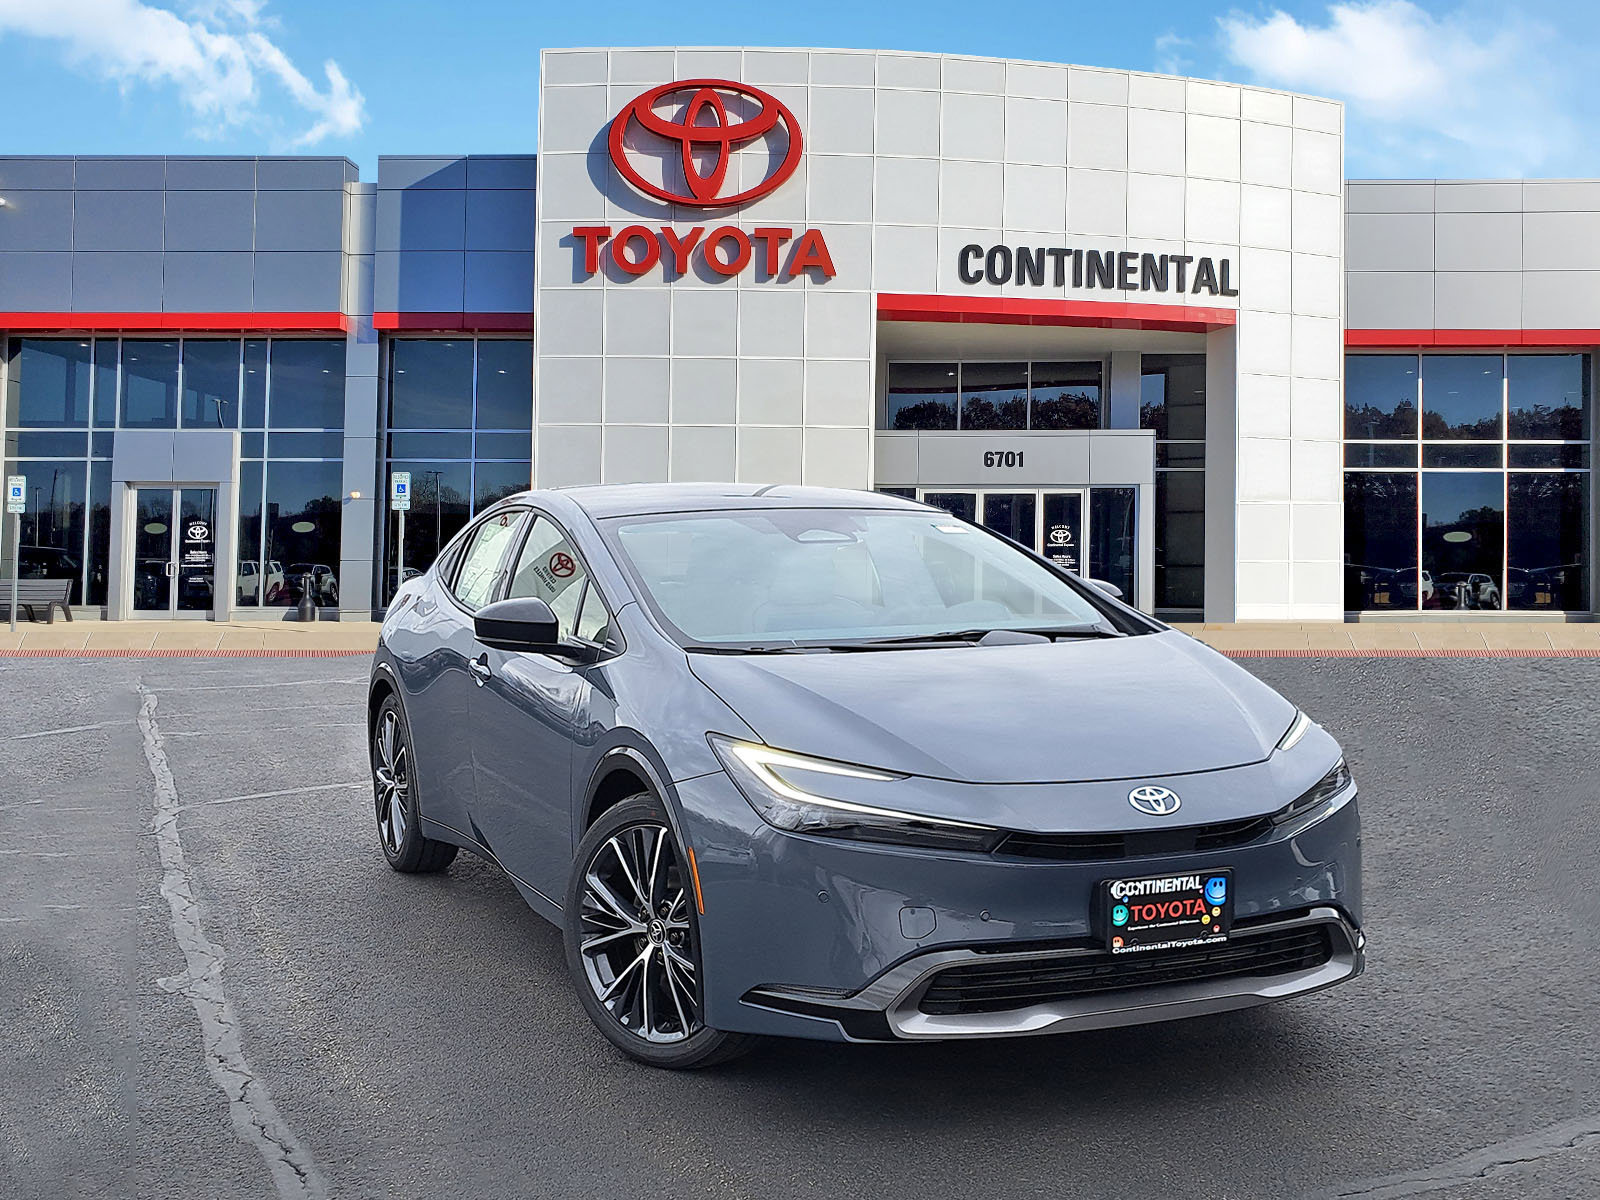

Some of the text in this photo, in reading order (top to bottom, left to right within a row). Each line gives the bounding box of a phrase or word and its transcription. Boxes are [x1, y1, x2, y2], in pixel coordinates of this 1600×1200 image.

[573, 226, 836, 278] TOYOTA
[959, 244, 1239, 297] CONTINENTAL
[983, 451, 1024, 468] 6701
[1111, 876, 1203, 898] CONTINENTAL
[1131, 898, 1206, 921] TOYOTA
[1112, 936, 1227, 954] ContinentalToyota.com
